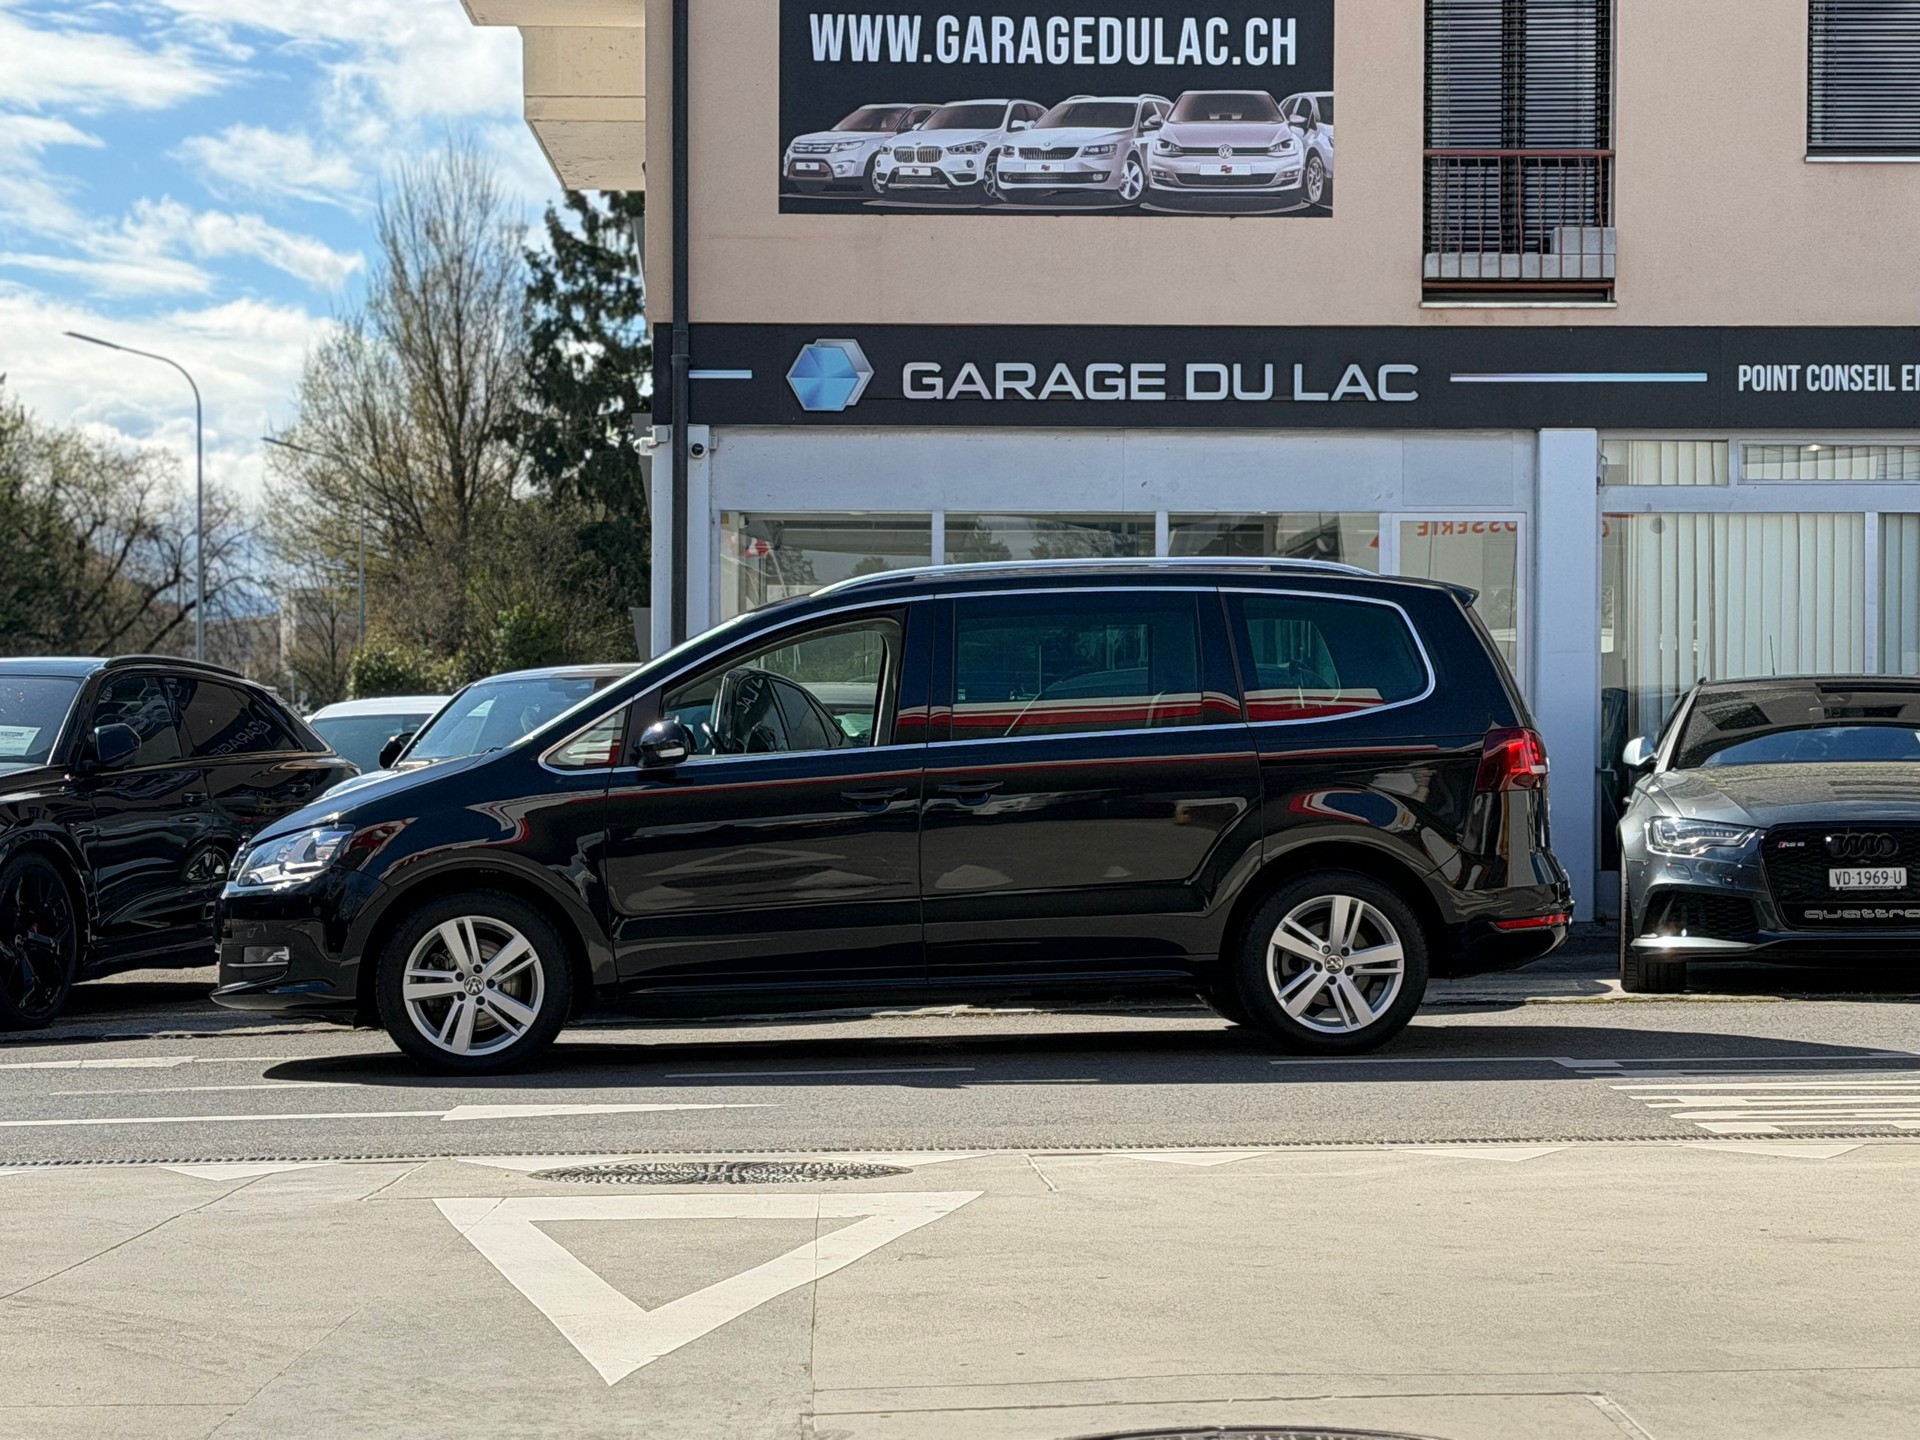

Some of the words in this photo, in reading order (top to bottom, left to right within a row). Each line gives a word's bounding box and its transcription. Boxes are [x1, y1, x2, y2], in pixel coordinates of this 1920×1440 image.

[809, 13, 1297, 66] WWW.GARAGEDULAC.CH
[902, 361, 1167, 401] GARAGE
[1185, 363, 1274, 401] DU
[1293, 363, 1419, 402] LAC
[1738, 364, 1801, 392] POINT
[1806, 364, 1896, 392] CONSEIL
[1804, 908, 1920, 920] quattro
